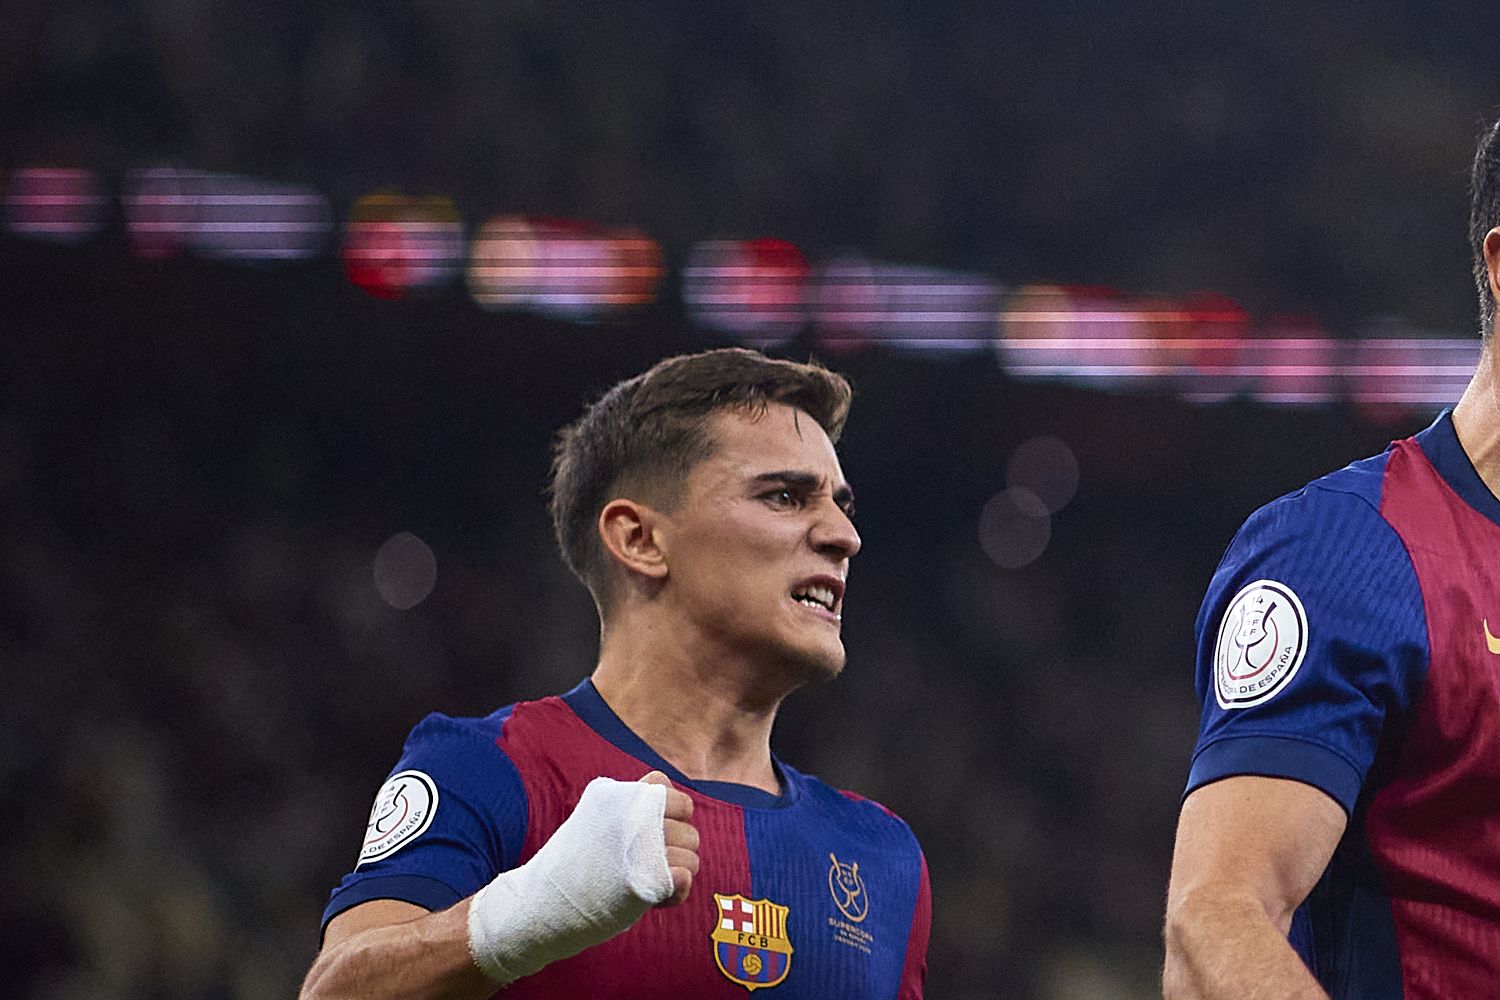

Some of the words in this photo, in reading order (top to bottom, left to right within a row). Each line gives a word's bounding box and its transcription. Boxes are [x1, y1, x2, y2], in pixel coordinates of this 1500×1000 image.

[1239, 683, 1257, 694] DE
[1257, 645, 1293, 689] ESPAÑA
[737, 933, 769, 949] FCB
